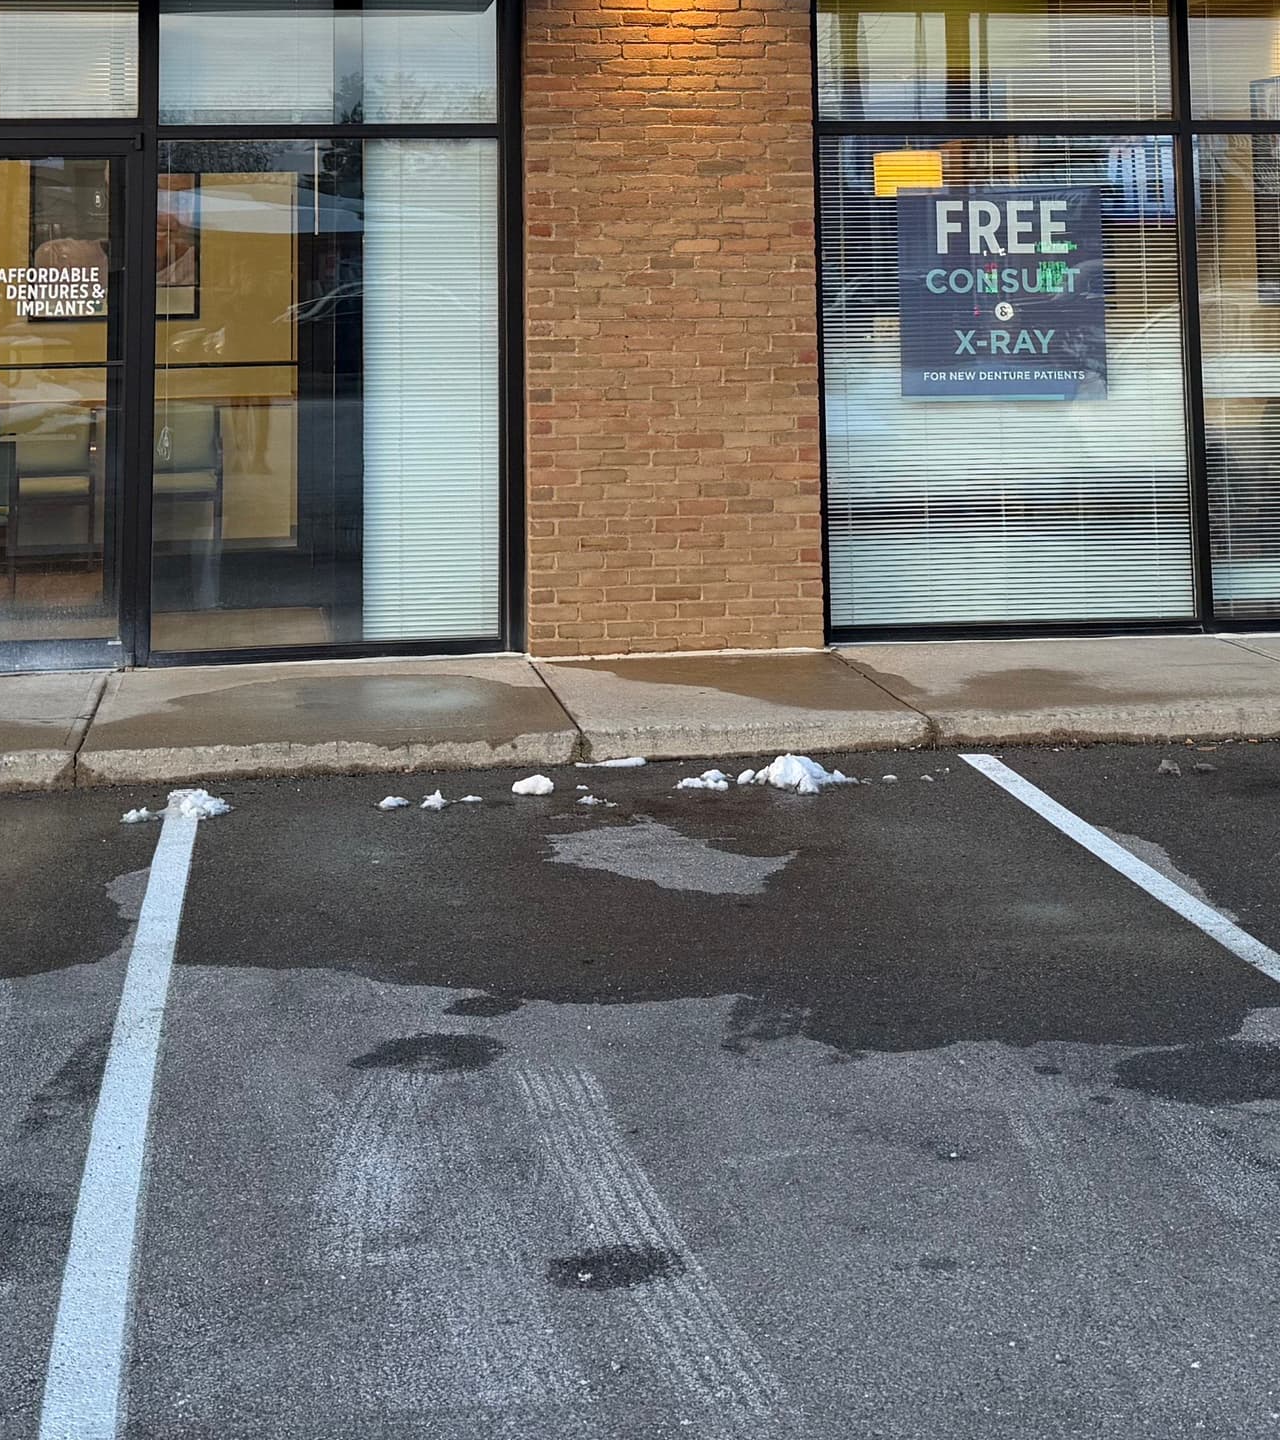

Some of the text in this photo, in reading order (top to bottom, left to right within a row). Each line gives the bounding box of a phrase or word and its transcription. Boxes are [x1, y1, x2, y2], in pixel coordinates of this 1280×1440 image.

[935, 200, 1070, 255] FREE
[6, 283, 105, 300] DENTURES &
[925, 268, 1081, 294] CONSULT
[954, 329, 1056, 355] X-RAY
[923, 370, 1086, 382] FOR NEW DENTURE PATIENTS
